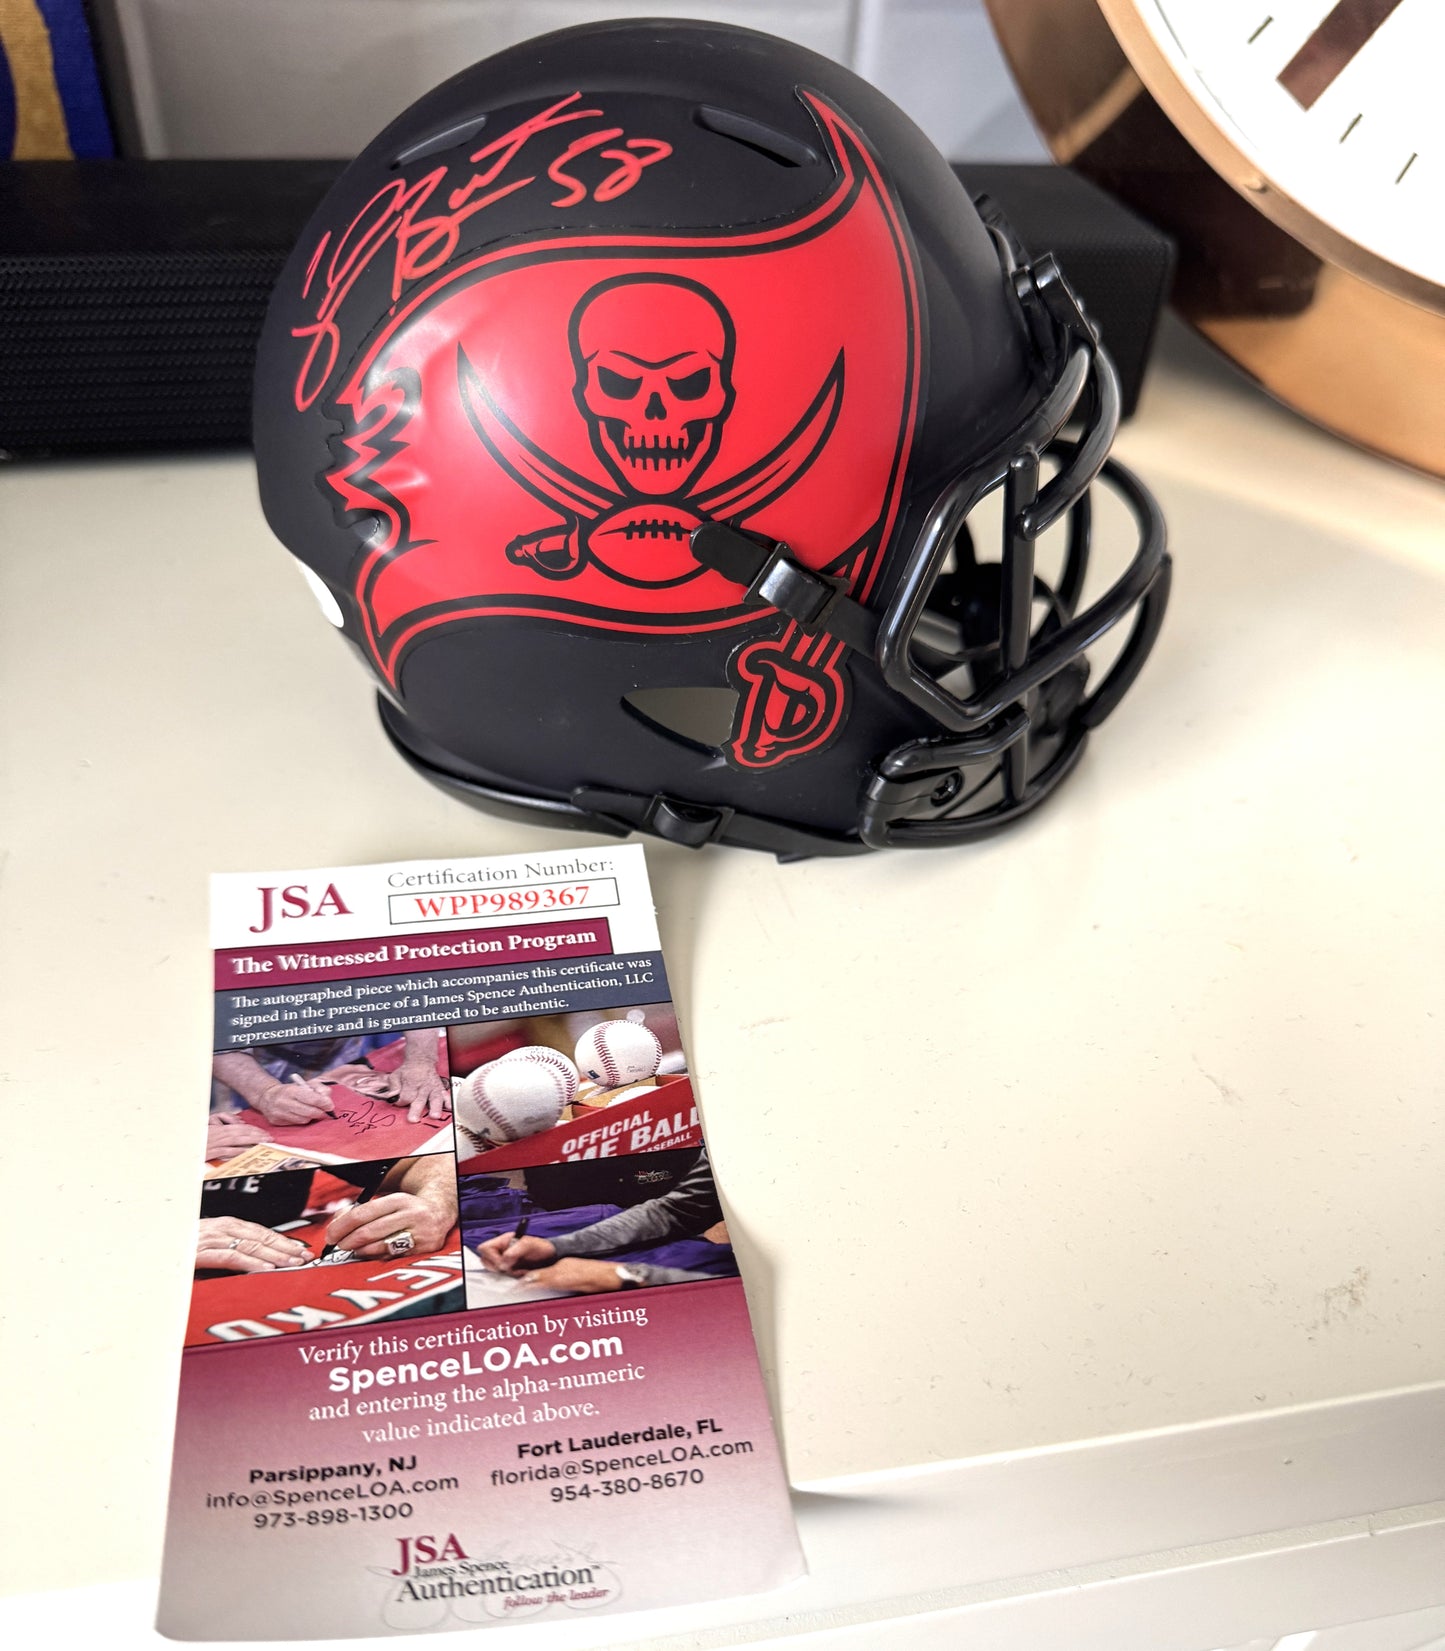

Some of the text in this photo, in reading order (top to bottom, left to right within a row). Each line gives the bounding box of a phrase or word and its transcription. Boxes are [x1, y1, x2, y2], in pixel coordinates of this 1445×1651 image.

[388, 858, 614, 888] Certification Number:
[249, 883, 354, 933] JSA
[414, 886, 589, 917] WPP989367
[232, 931, 597, 975] The Witnessed Protection Program
[232, 959, 652, 1008] The autographed piece which accompanies this certificate was
[232, 972, 654, 1027] signed in the presence of a James Spence Authentication, LLC
[231, 998, 569, 1044] representative and is guaranteed to be authentic.
[561, 1110, 654, 1154] OFFICIAL
[298, 1307, 649, 1364] Verify this certification by visiting
[328, 1336, 624, 1395] SpenceLOA.com
[309, 1363, 646, 1420] and entering the alpha-numeric
[362, 1402, 600, 1443] value indicated above.
[517, 1418, 723, 1458] Fort Lauderdale, FL
[249, 1455, 417, 1484] Parsippany, NJ
[491, 1439, 754, 1486] florida@SpenceLOA.com
[206, 1476, 459, 1508] info@SpenceLOA.com
[550, 1468, 705, 1502] 954-380-8670
[254, 1502, 413, 1528] 973-898-1300
[391, 1532, 470, 1577] JSA
[413, 1560, 509, 1580] James Spence
[504, 1588, 610, 1610] follow the leader
